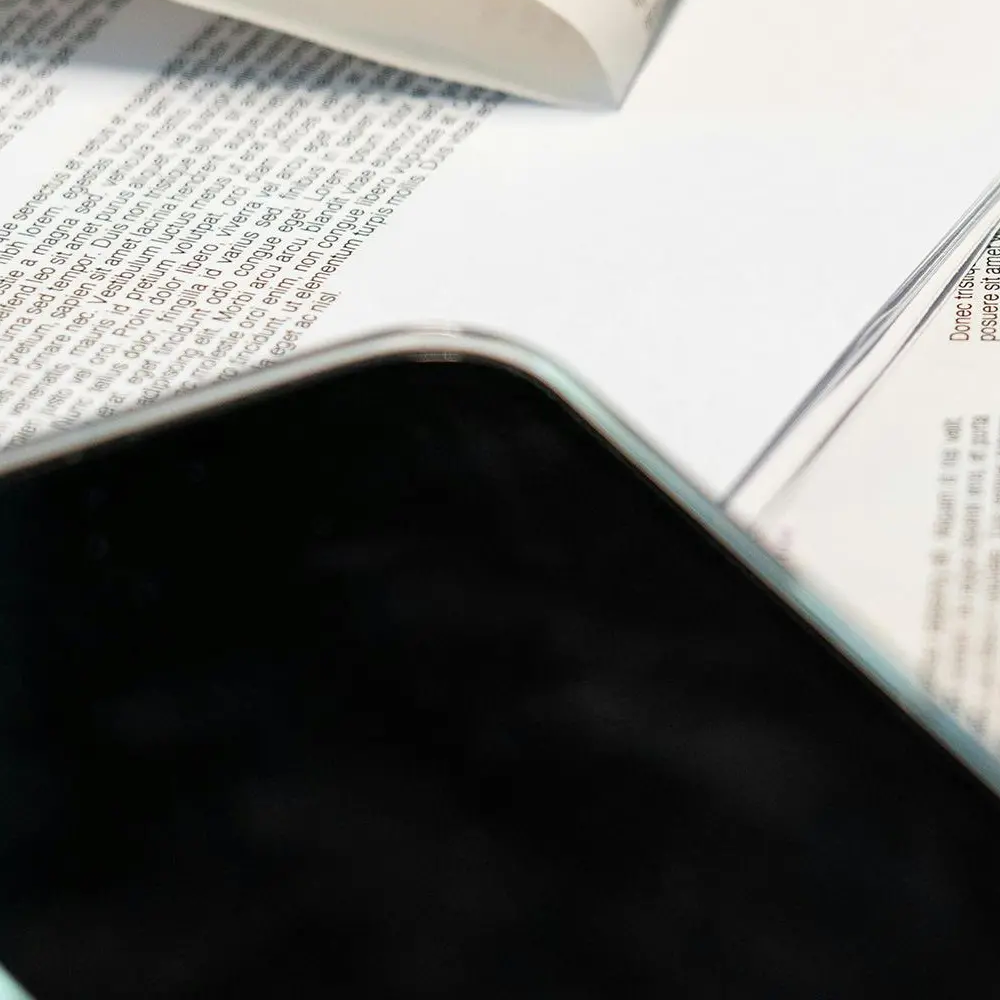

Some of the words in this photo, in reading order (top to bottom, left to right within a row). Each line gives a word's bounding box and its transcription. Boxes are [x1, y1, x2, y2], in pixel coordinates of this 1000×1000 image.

[20, 258, 39, 267] a
[32, 218, 80, 256] magna
[25, 266, 56, 284] leo
[49, 251, 73, 266] sit
[65, 222, 102, 251] amet
[94, 190, 135, 223] purus
[26, 293, 56, 315] sed
[46, 253, 101, 292] tempor.
[90, 221, 129, 249] Duis
[122, 201, 152, 222] non
[50, 282, 97, 319] sapien
[89, 267, 113, 282] sit
[104, 238, 142, 267] amet
[129, 203, 178, 238] lacinia
[65, 310, 98, 333] nec.
[87, 245, 162, 304] Vestibulum
[150, 211, 197, 244] luctus
[190, 177, 232, 210] metus
[68, 319, 116, 356] mauris
[106, 303, 131, 316] id
[125, 259, 177, 301] pretium
[170, 212, 228, 255] volutpat,
[221, 185, 248, 207] orci
[111, 308, 155, 338] Proin
[148, 276, 185, 306] dolor
[176, 243, 225, 275] libero,
[216, 201, 263, 237] viverra
[156, 283, 209, 323] fringilla
[198, 267, 223, 280] id
[217, 231, 260, 264] varius
[254, 206, 288, 228] sed,
[206, 280, 238, 305] odio
[233, 236, 282, 277] congue
[277, 208, 311, 233] eget.
[211, 290, 256, 323] Morbi
[249, 264, 282, 290] arcu
[275, 237, 315, 263] arcu,
[300, 197, 349, 233] blandit
[238, 306, 268, 329] orci
[262, 276, 303, 305] enim,
[293, 250, 324, 273] non
[317, 208, 365, 249] congue
[354, 177, 396, 207] libero
[282, 300, 303, 313] ut
[295, 238, 363, 299] elementum
[352, 207, 394, 237] turpis
[980, 277, 1000, 291] sit
[269, 329, 302, 359] eget
[294, 314, 318, 329] ac
[310, 291, 342, 313] nisl.
[949, 303, 972, 341] Donec
[980, 293, 1000, 342] posuere
